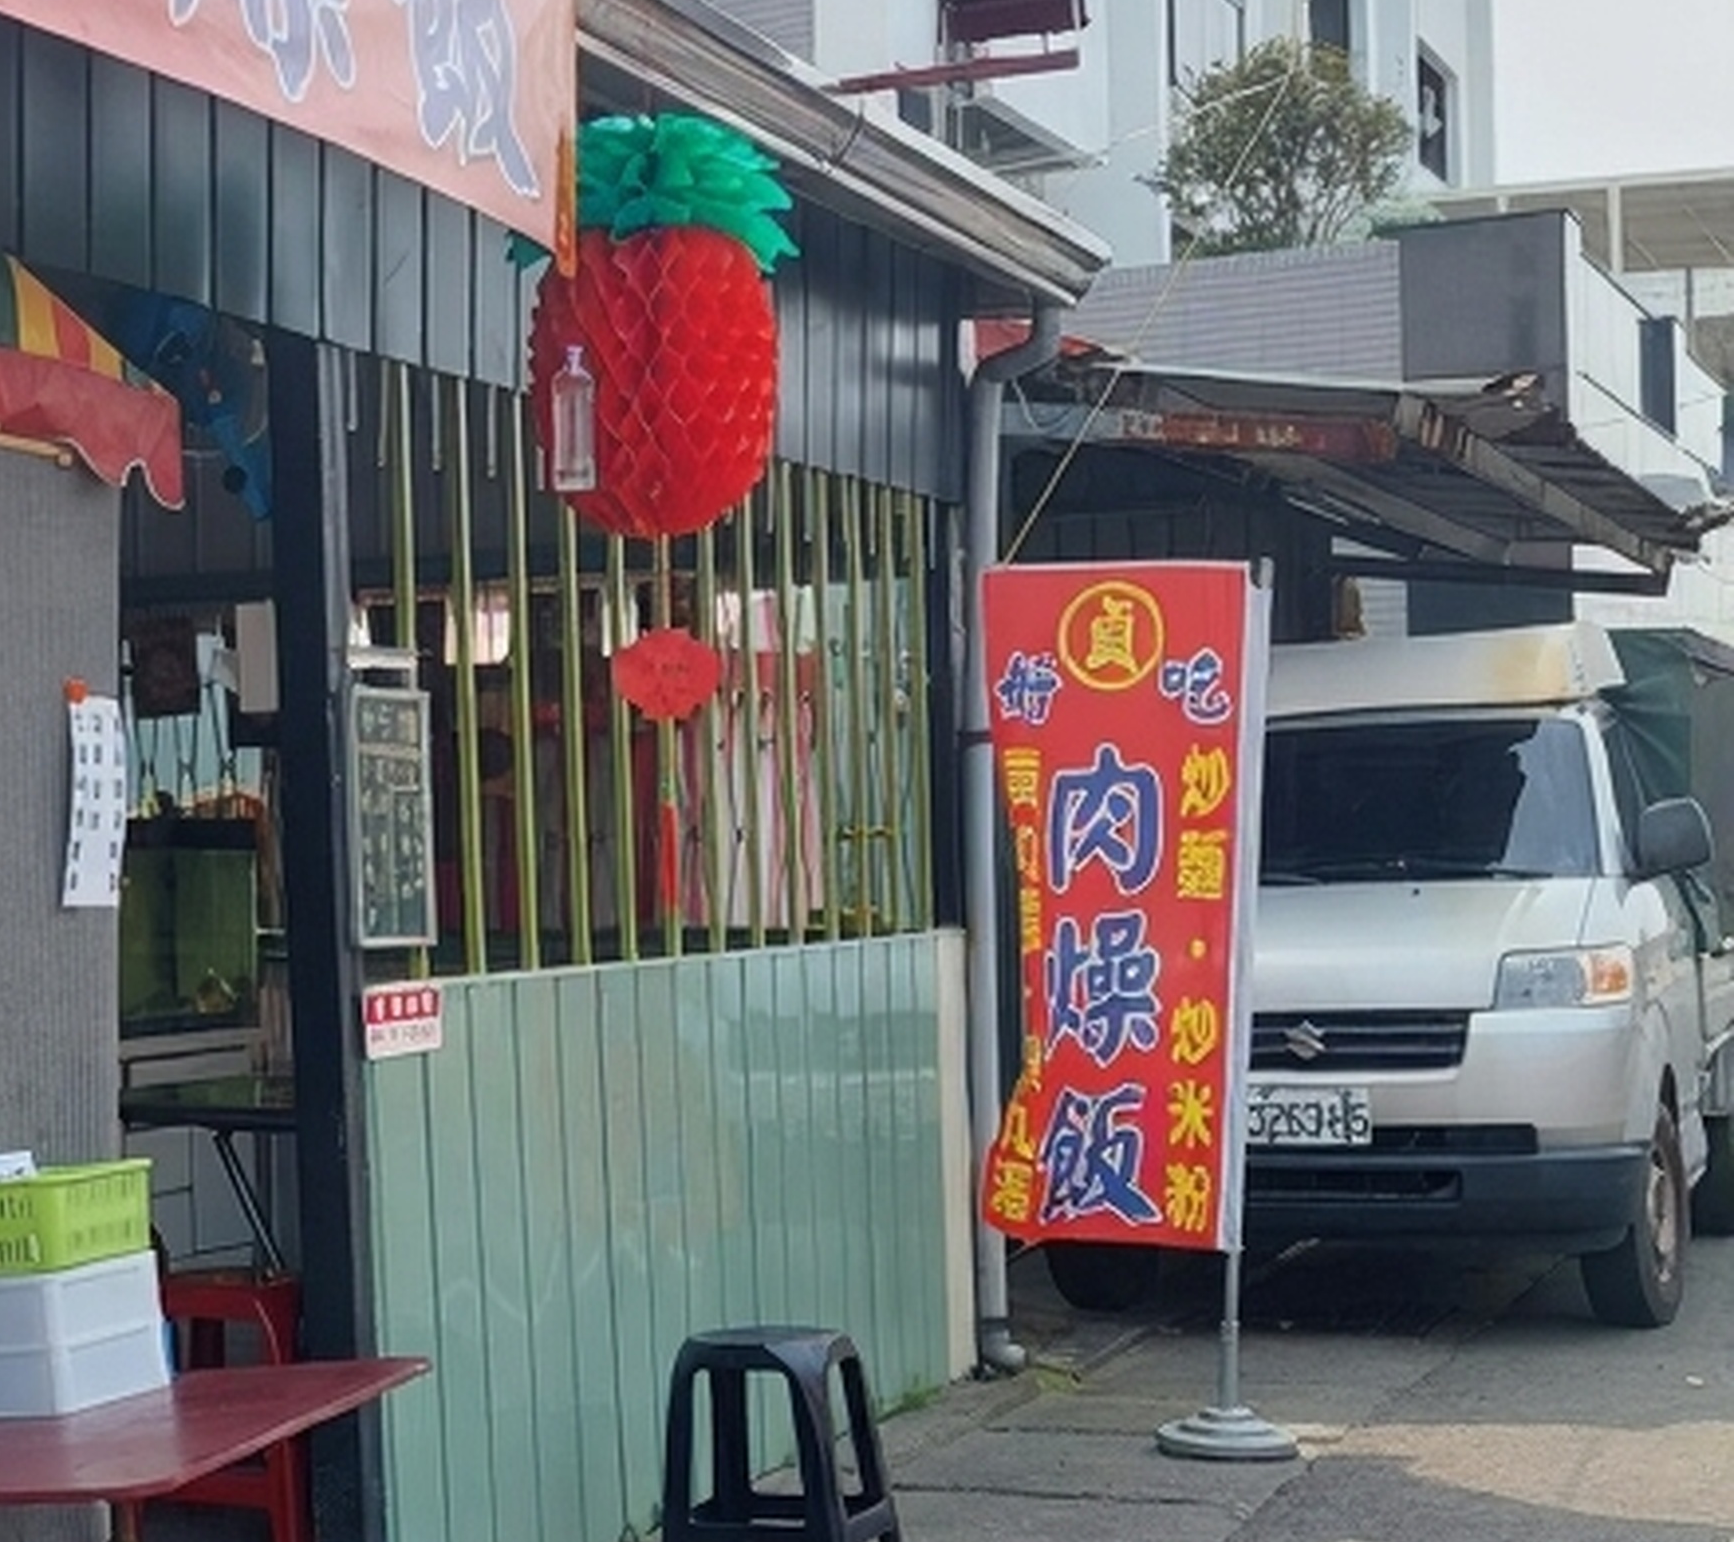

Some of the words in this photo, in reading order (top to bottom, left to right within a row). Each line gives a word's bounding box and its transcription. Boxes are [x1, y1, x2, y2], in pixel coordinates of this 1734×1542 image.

[1086, 593, 1140, 675] 貞
[1043, 742, 1164, 1225] 肉燥飯
